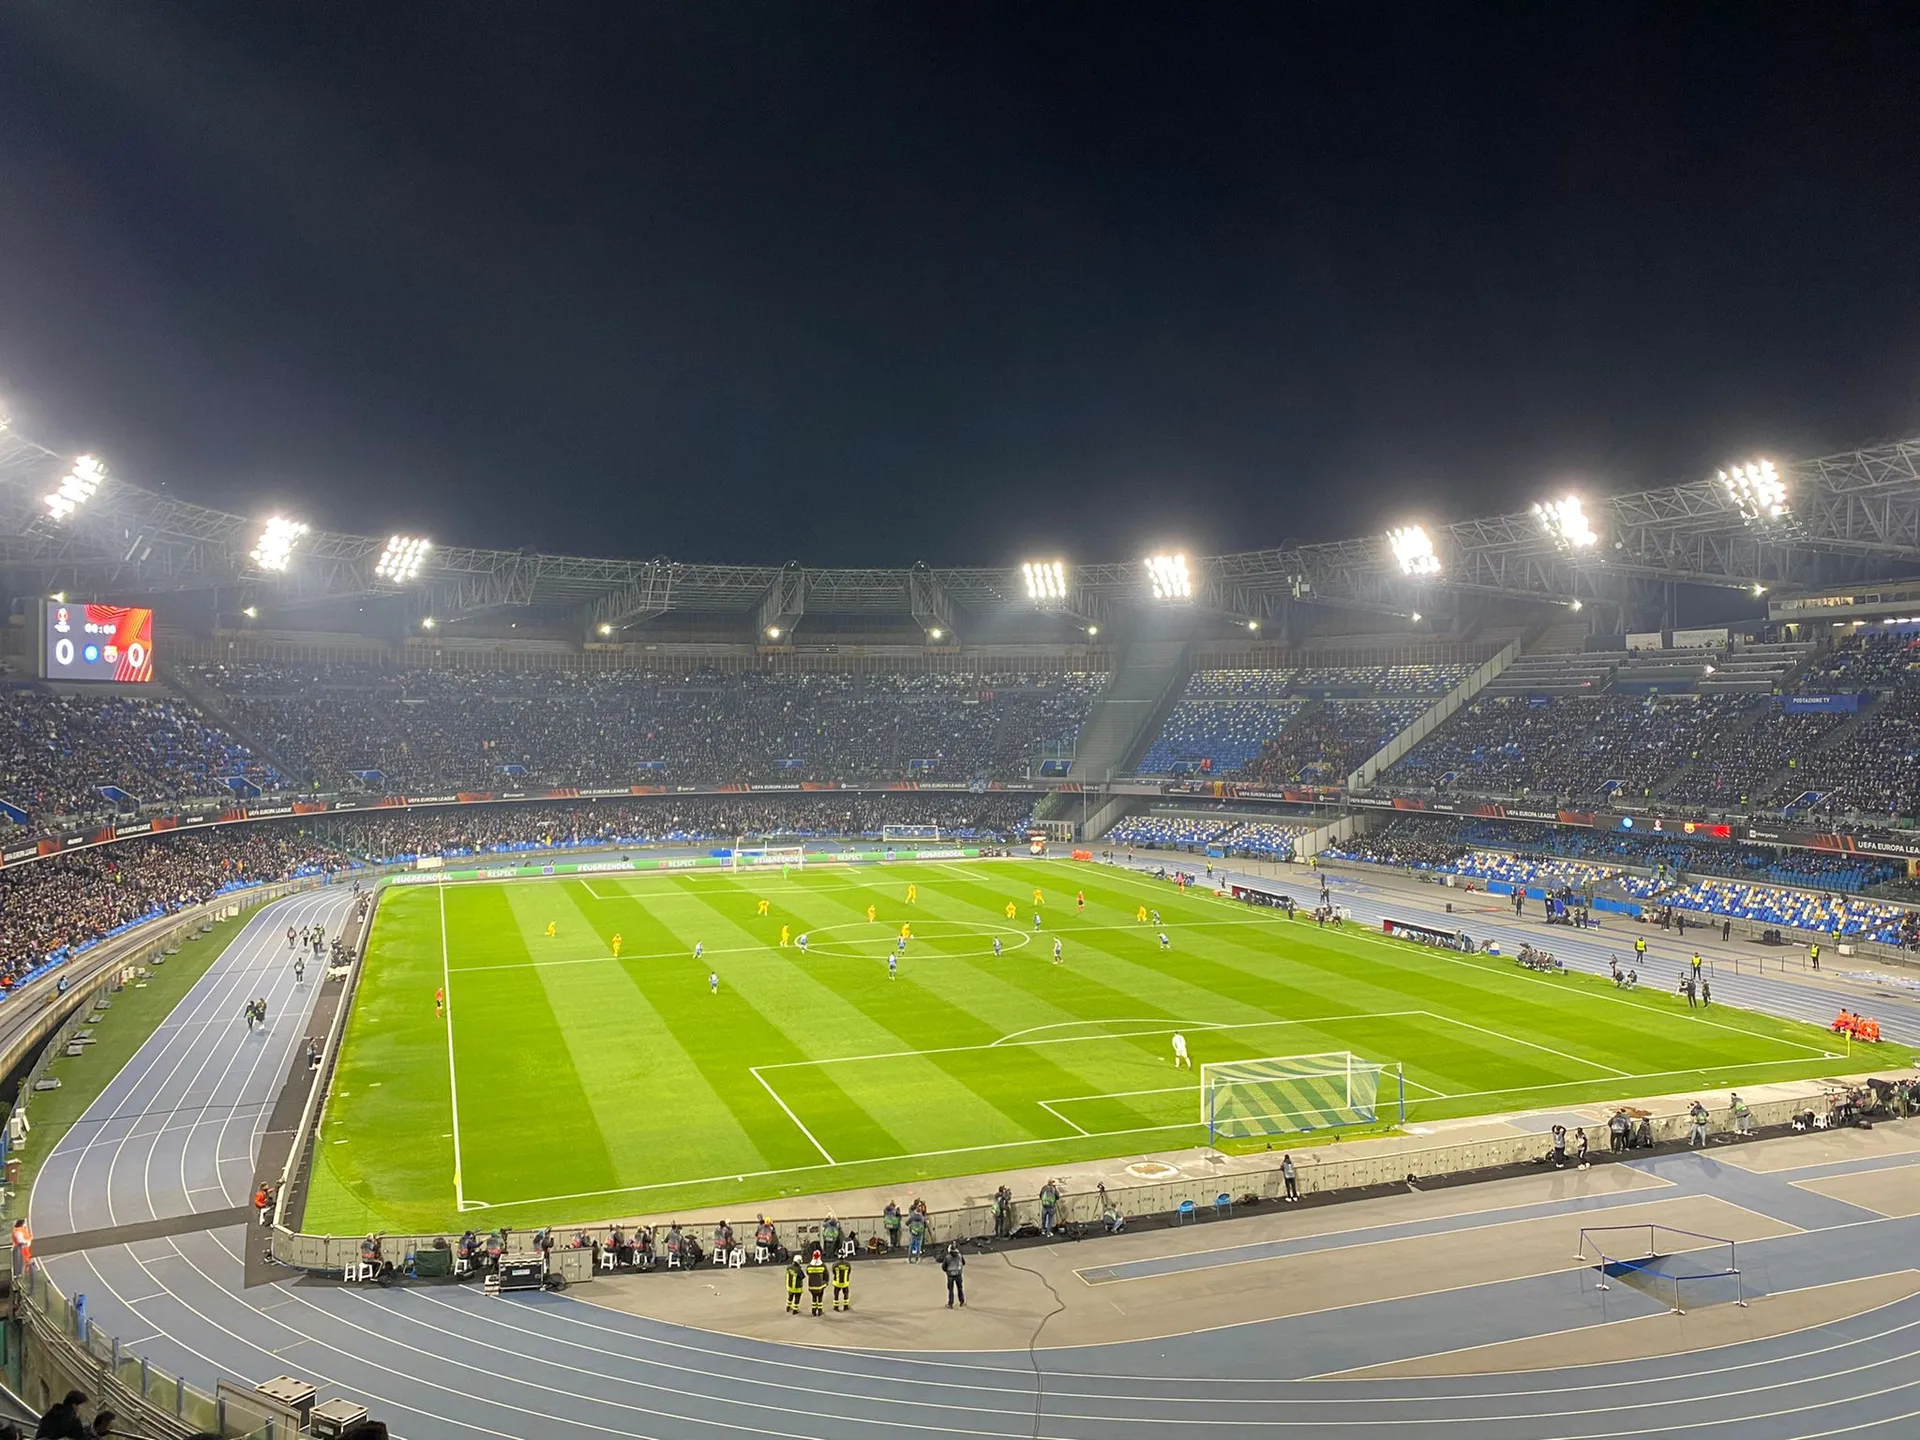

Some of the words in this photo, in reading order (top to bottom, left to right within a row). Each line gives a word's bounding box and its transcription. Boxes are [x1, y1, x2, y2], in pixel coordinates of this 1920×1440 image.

[55, 638, 74, 665] 0
[128, 642, 145, 668] 0
[1538, 812, 1556, 820] LEAGUE
[1858, 841, 1877, 850] UEFA
[1877, 843, 1905, 853] EUROPA
[577, 863, 635, 872] #EUGREENDEAL
[668, 859, 696, 868] RESPECT
[487, 869, 517, 878] RESPECT
